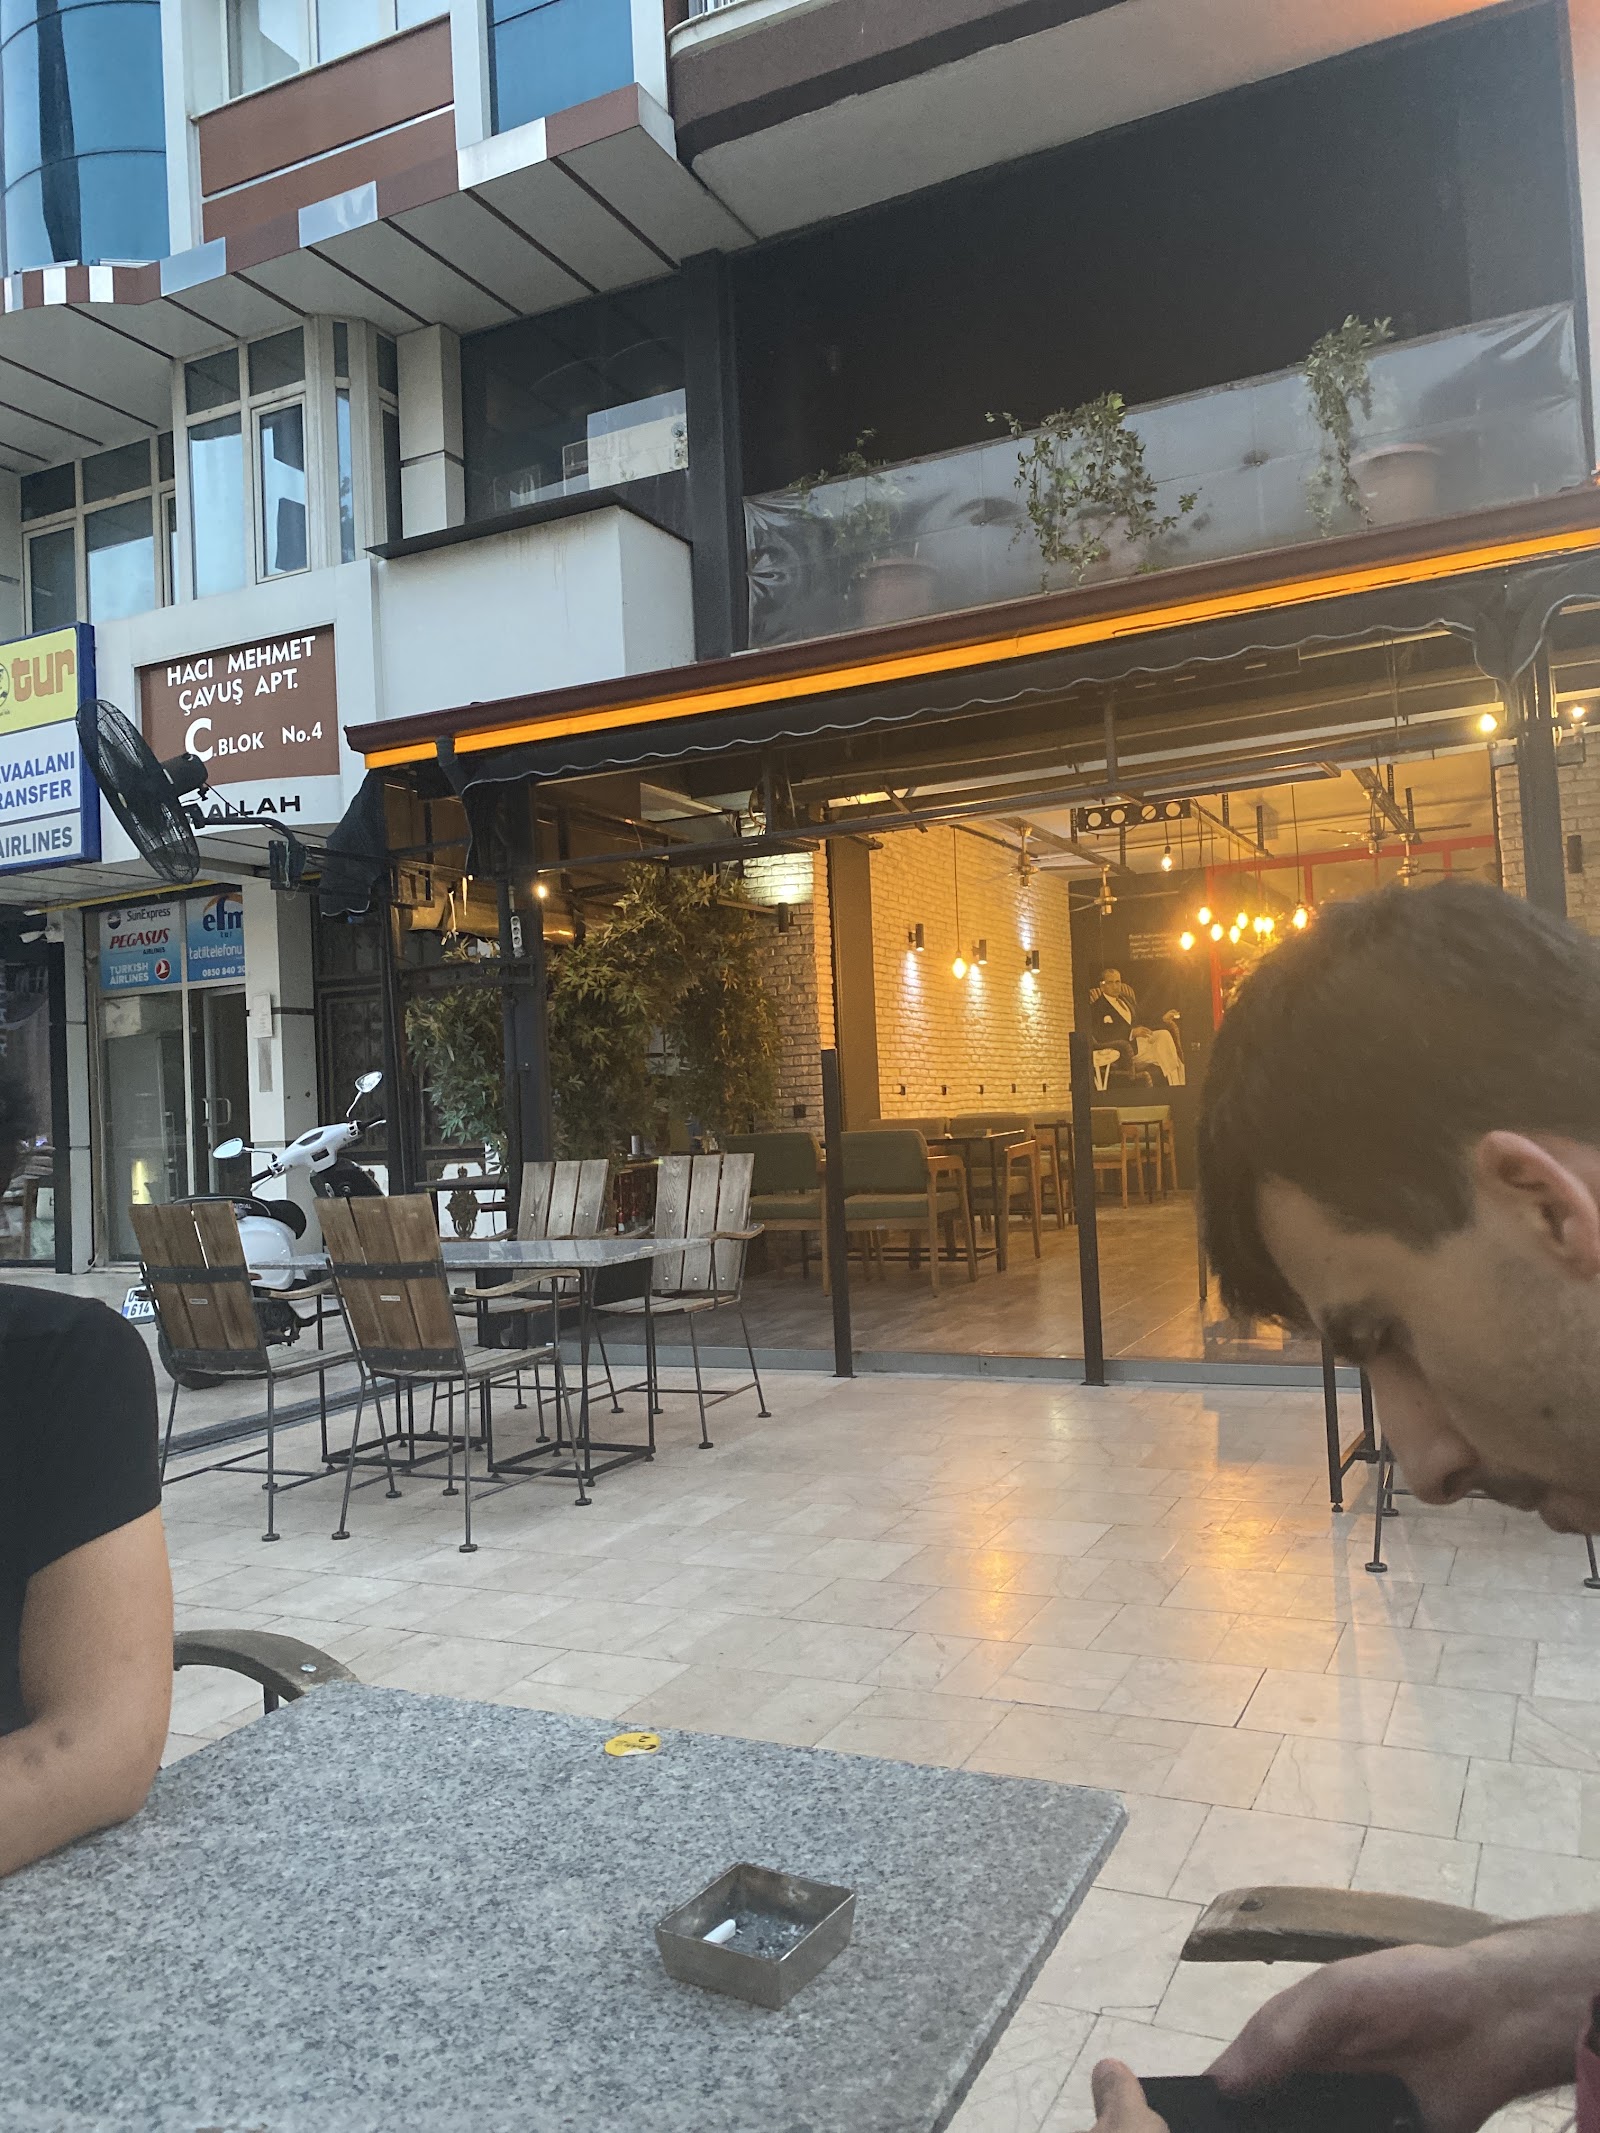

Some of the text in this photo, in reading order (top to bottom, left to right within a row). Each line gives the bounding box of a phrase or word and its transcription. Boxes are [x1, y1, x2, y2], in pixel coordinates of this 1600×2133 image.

[166, 635, 316, 687] HACI MEHMET
[12, 649, 75, 702] tur
[178, 668, 298, 716] ÇAVUŞ APT.
[0, 751, 75, 783] VAALANI
[207, 795, 301, 819] ALLAH
[126, 907, 171, 922] SunExpress
[109, 927, 171, 949] PEGASUS
[109, 972, 149, 985] AIRLINES
[110, 962, 149, 976] TURKISH
[130, 1302, 150, 1316] 614
